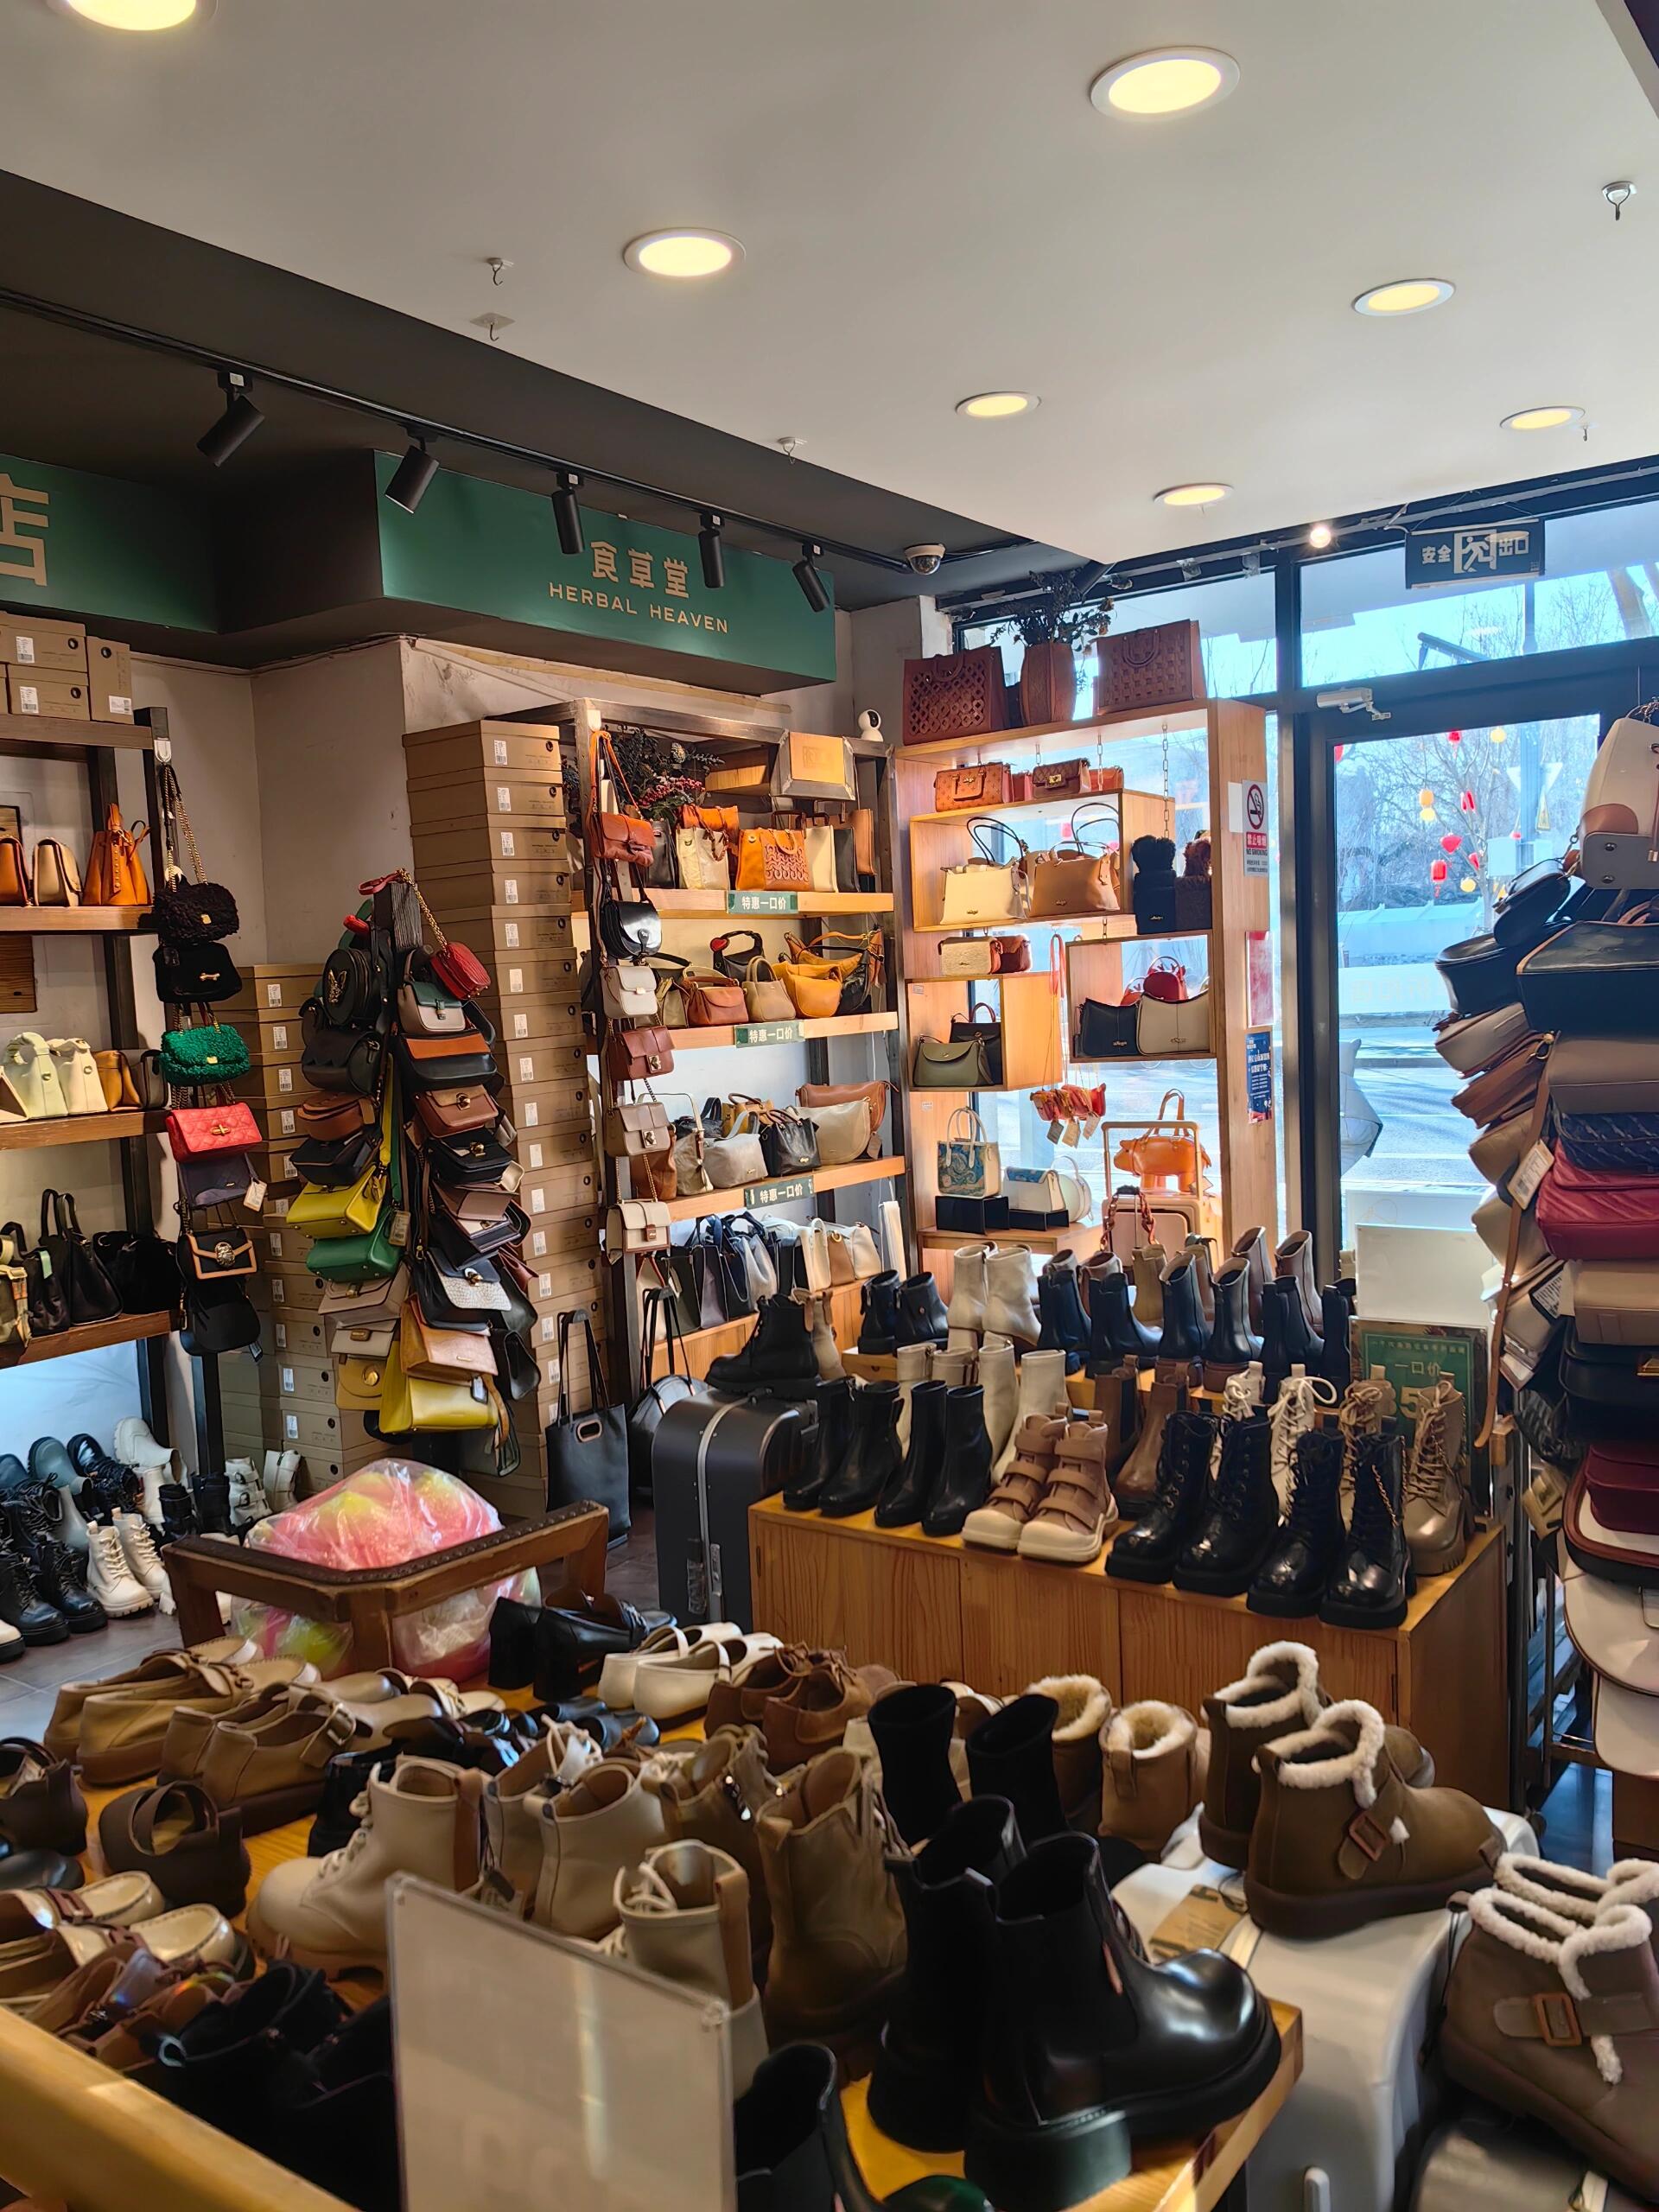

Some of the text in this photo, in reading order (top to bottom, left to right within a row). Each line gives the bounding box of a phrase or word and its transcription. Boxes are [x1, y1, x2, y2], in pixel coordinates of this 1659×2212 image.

[1421, 537, 1529, 564] 安全 出口
[590, 540, 690, 599] 食草堂
[549, 582, 728, 633] HERBAL HEAVEN
[741, 896, 786, 910] 特惠一口价
[749, 1026, 792, 1043] 特惠一口价
[760, 1183, 803, 1203] 特惠一口价
[1395, 1361, 1441, 1376] 一口价
